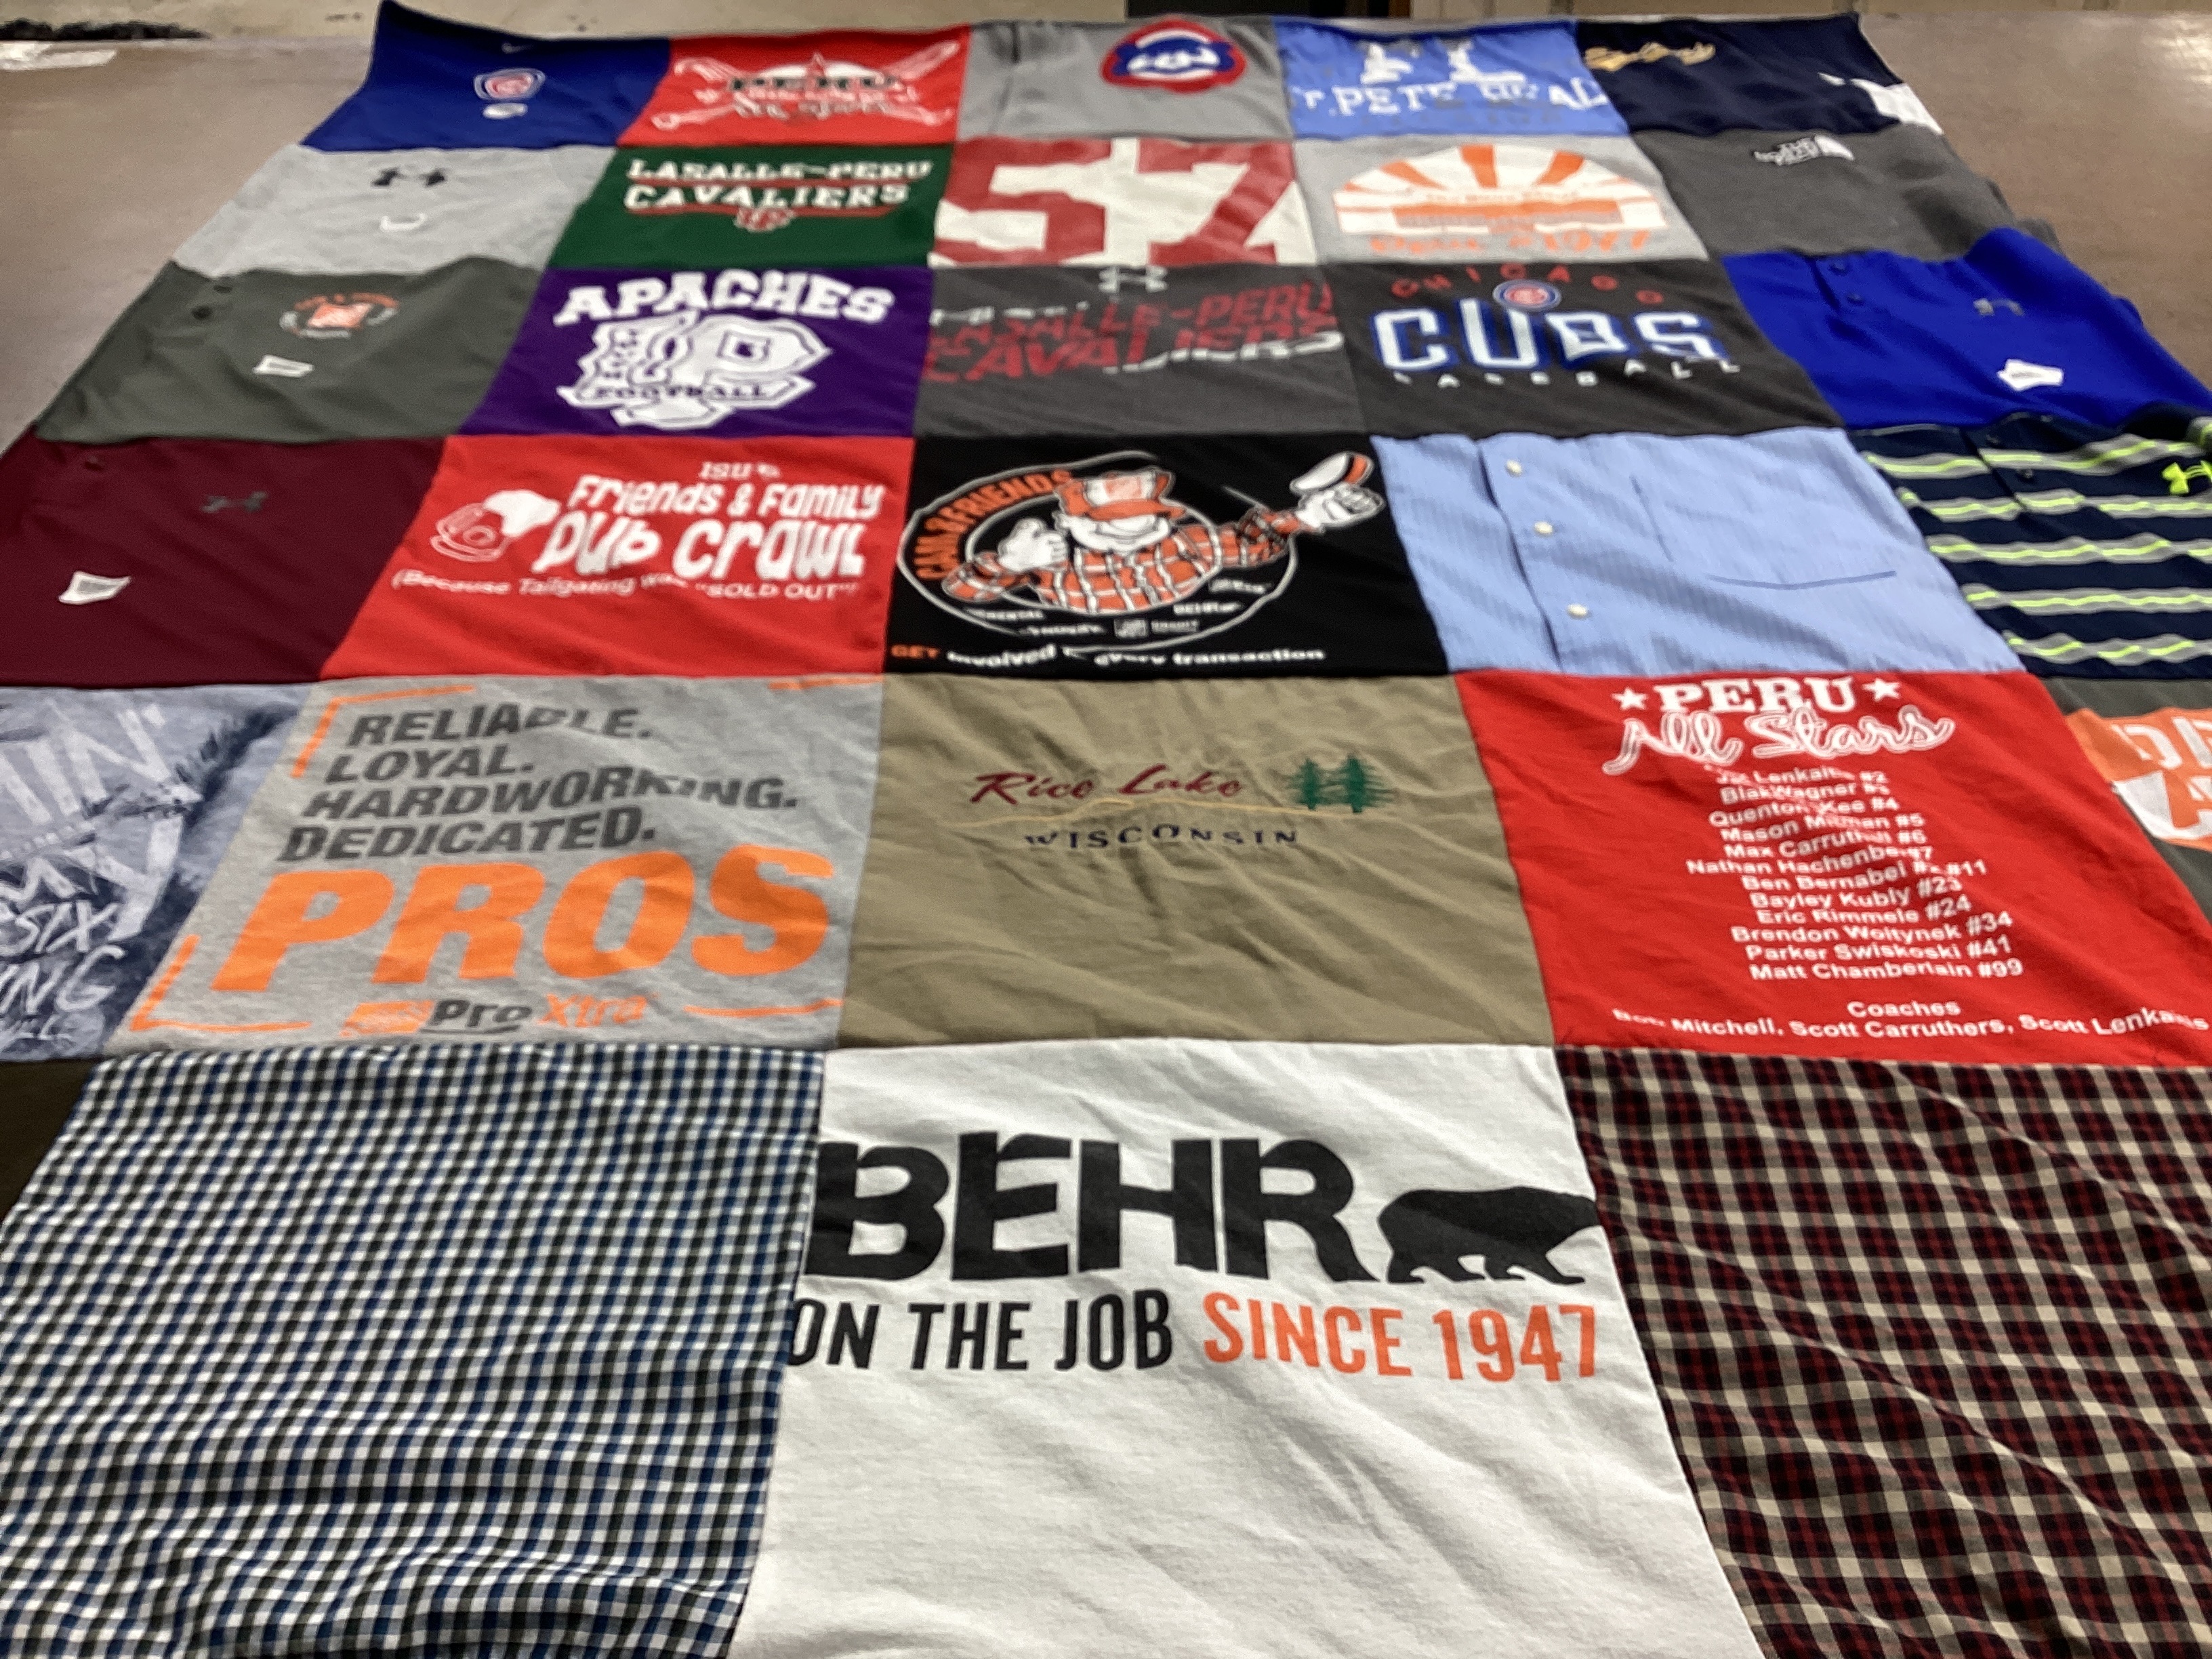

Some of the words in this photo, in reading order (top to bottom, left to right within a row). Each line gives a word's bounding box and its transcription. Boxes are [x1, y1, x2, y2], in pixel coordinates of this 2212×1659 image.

[624, 184, 909, 210] CAVALIERS
[556, 269, 895, 325] APACHES
[1370, 298, 1732, 371] CUBS
[567, 474, 724, 515] Friends
[1654, 677, 1856, 714] PERU
[1743, 703, 1956, 760] Stars
[325, 744, 535, 784] LOYAL.
[302, 764, 798, 819] HARDWORKING.
[276, 806, 655, 862] DEDICATED.
[1025, 823, 1297, 850] WISCONSIN
[1720, 819, 1799, 842] Mason
[1685, 859, 1773, 875] Nathan
[1723, 843, 1774, 859] Max
[210, 843, 834, 992] PROS
[1730, 925, 1841, 943] Brandon
[1967, 910, 2014, 937] #34
[1745, 943, 1828, 962] Parker
[1967, 933, 2012, 959] #41
[1748, 963, 1808, 981] Matt
[1811, 960, 1973, 979] Chamberlain
[1977, 957, 2024, 979] #99
[432, 998, 532, 1028] Pro
[1847, 1000, 1961, 1018] Coaches
[1789, 1019, 1860, 1038] Scott
[804, 1132, 1379, 1282] BEHR
[788, 1298, 881, 1370] ON
[908, 1301, 1031, 1370] THE
[1054, 1289, 1174, 1372] JOB
[1202, 1292, 1412, 1377] SINCE
[1432, 1305, 1597, 1382] 1947
